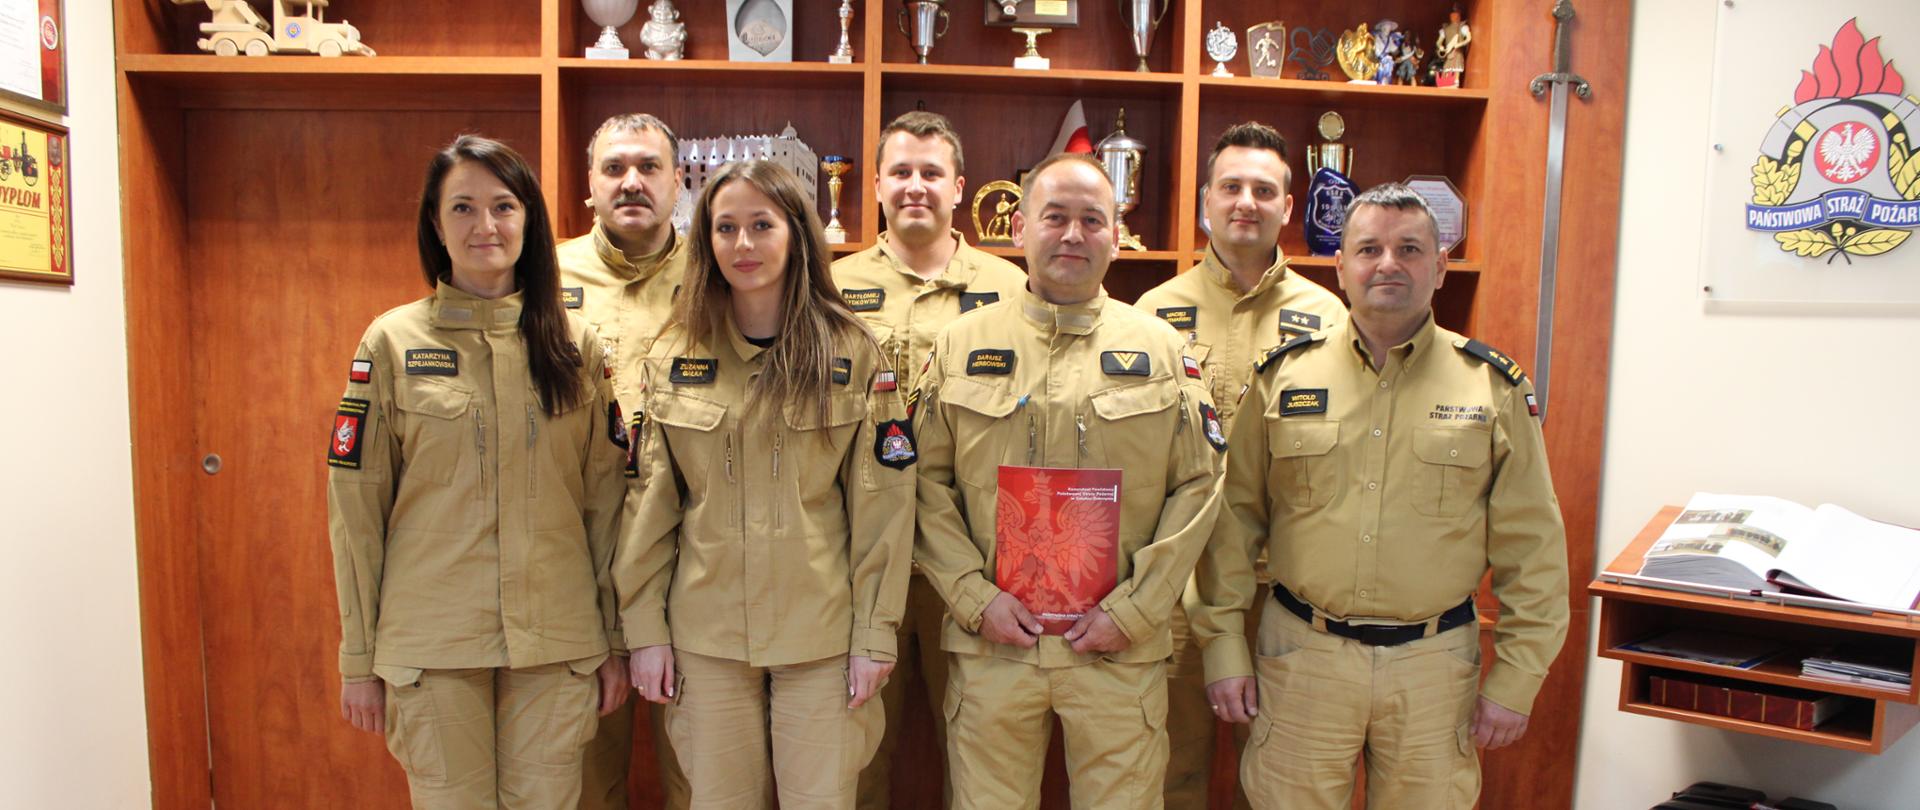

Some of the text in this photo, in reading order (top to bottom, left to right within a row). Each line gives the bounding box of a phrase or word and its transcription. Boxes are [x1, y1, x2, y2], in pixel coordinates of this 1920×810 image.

[0, 186, 41, 209] YPLOM
[1749, 195, 1920, 227] PAŃSTWOWA STRAŻ POŻAR
[847, 298, 879, 306] YDKOWSKI
